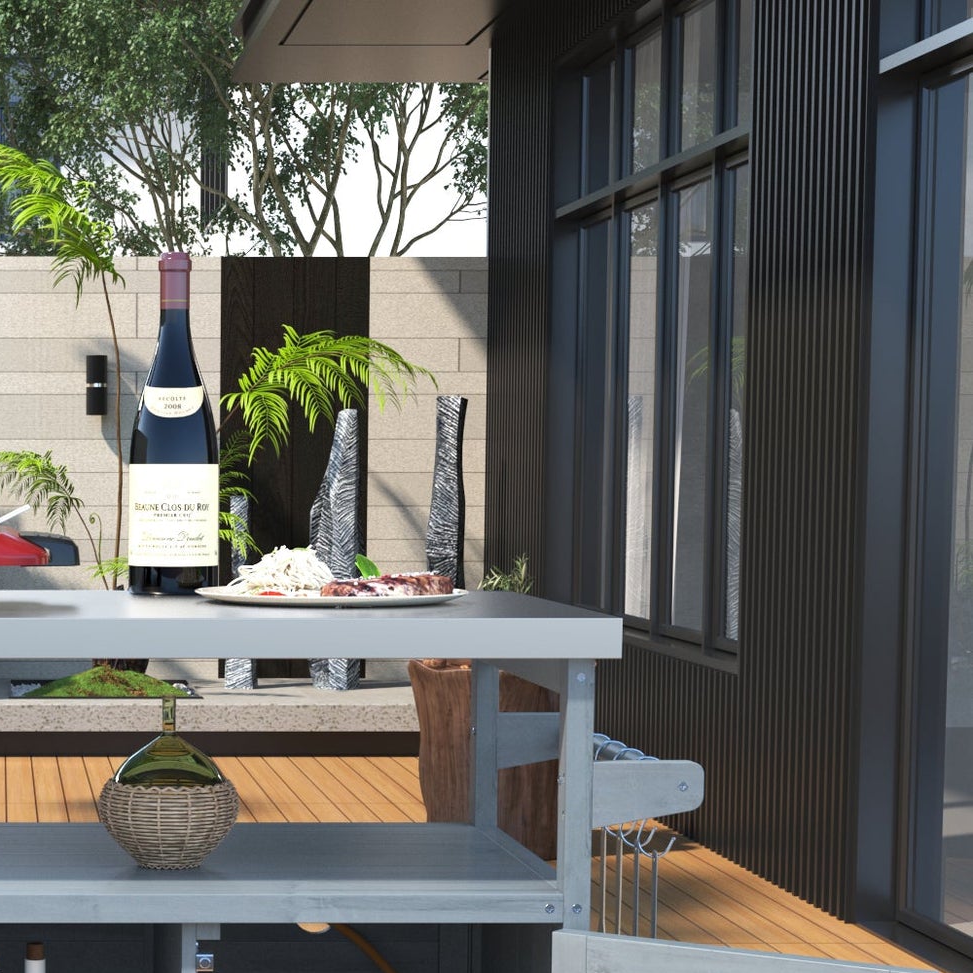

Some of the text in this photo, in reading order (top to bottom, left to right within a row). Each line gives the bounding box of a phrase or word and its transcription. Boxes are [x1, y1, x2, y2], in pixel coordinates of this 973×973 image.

[160, 502, 182, 511] CLOS
[183, 503, 195, 511] DU
[196, 502, 210, 511] ROY
